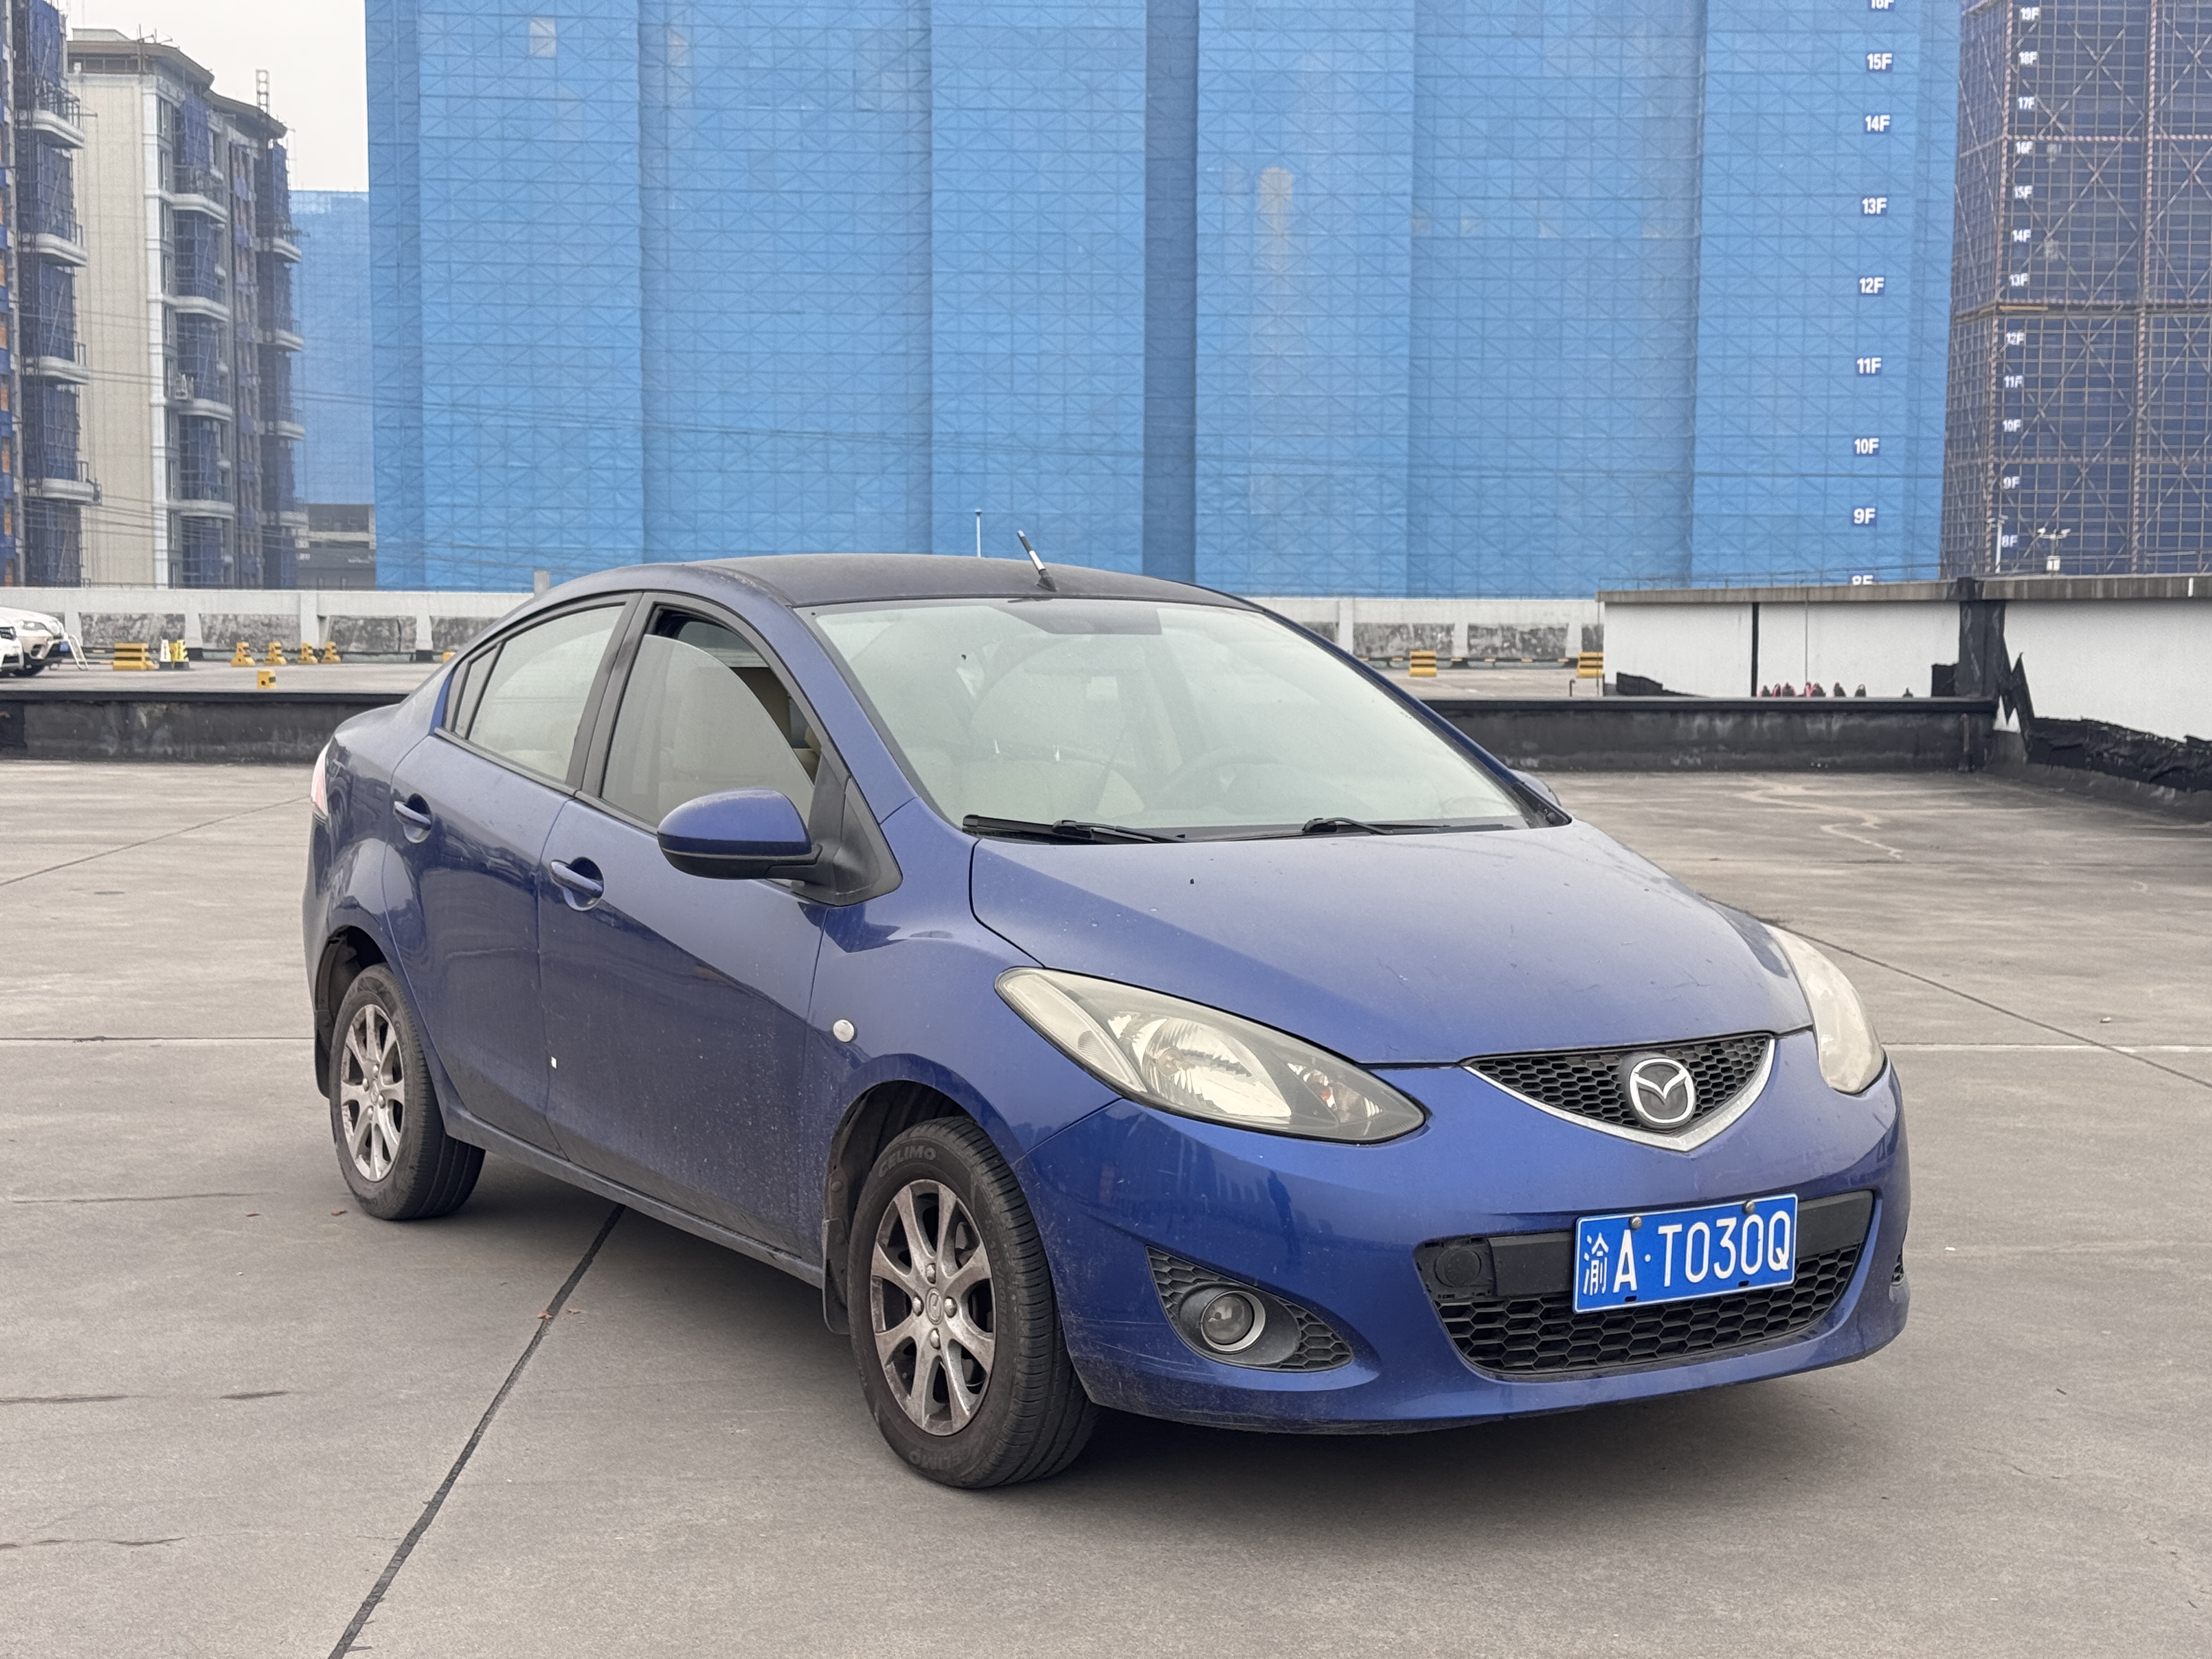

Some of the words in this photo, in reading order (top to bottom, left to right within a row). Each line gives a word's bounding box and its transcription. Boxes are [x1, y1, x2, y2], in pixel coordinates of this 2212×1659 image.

[1867, 53, 1892, 70] 15F
[2017, 96, 2035, 110] 17F
[1865, 115, 1890, 131] 14F
[1862, 198, 1887, 214] 13F
[2012, 229, 2031, 242] 14F
[1860, 278, 1884, 294] 12F
[2010, 273, 2028, 286] 13F
[2006, 332, 2024, 346] 12F
[1857, 358, 1881, 374] 11F
[2004, 375, 2023, 388] 11F
[2003, 419, 2021, 432] 10F
[1854, 438, 1879, 454] 10F
[2003, 476, 2019, 489] 9F
[1854, 508, 1876, 524] 9F
[2002, 534, 2018, 547] 8F
[878, 1145, 937, 1178] CELIMO
